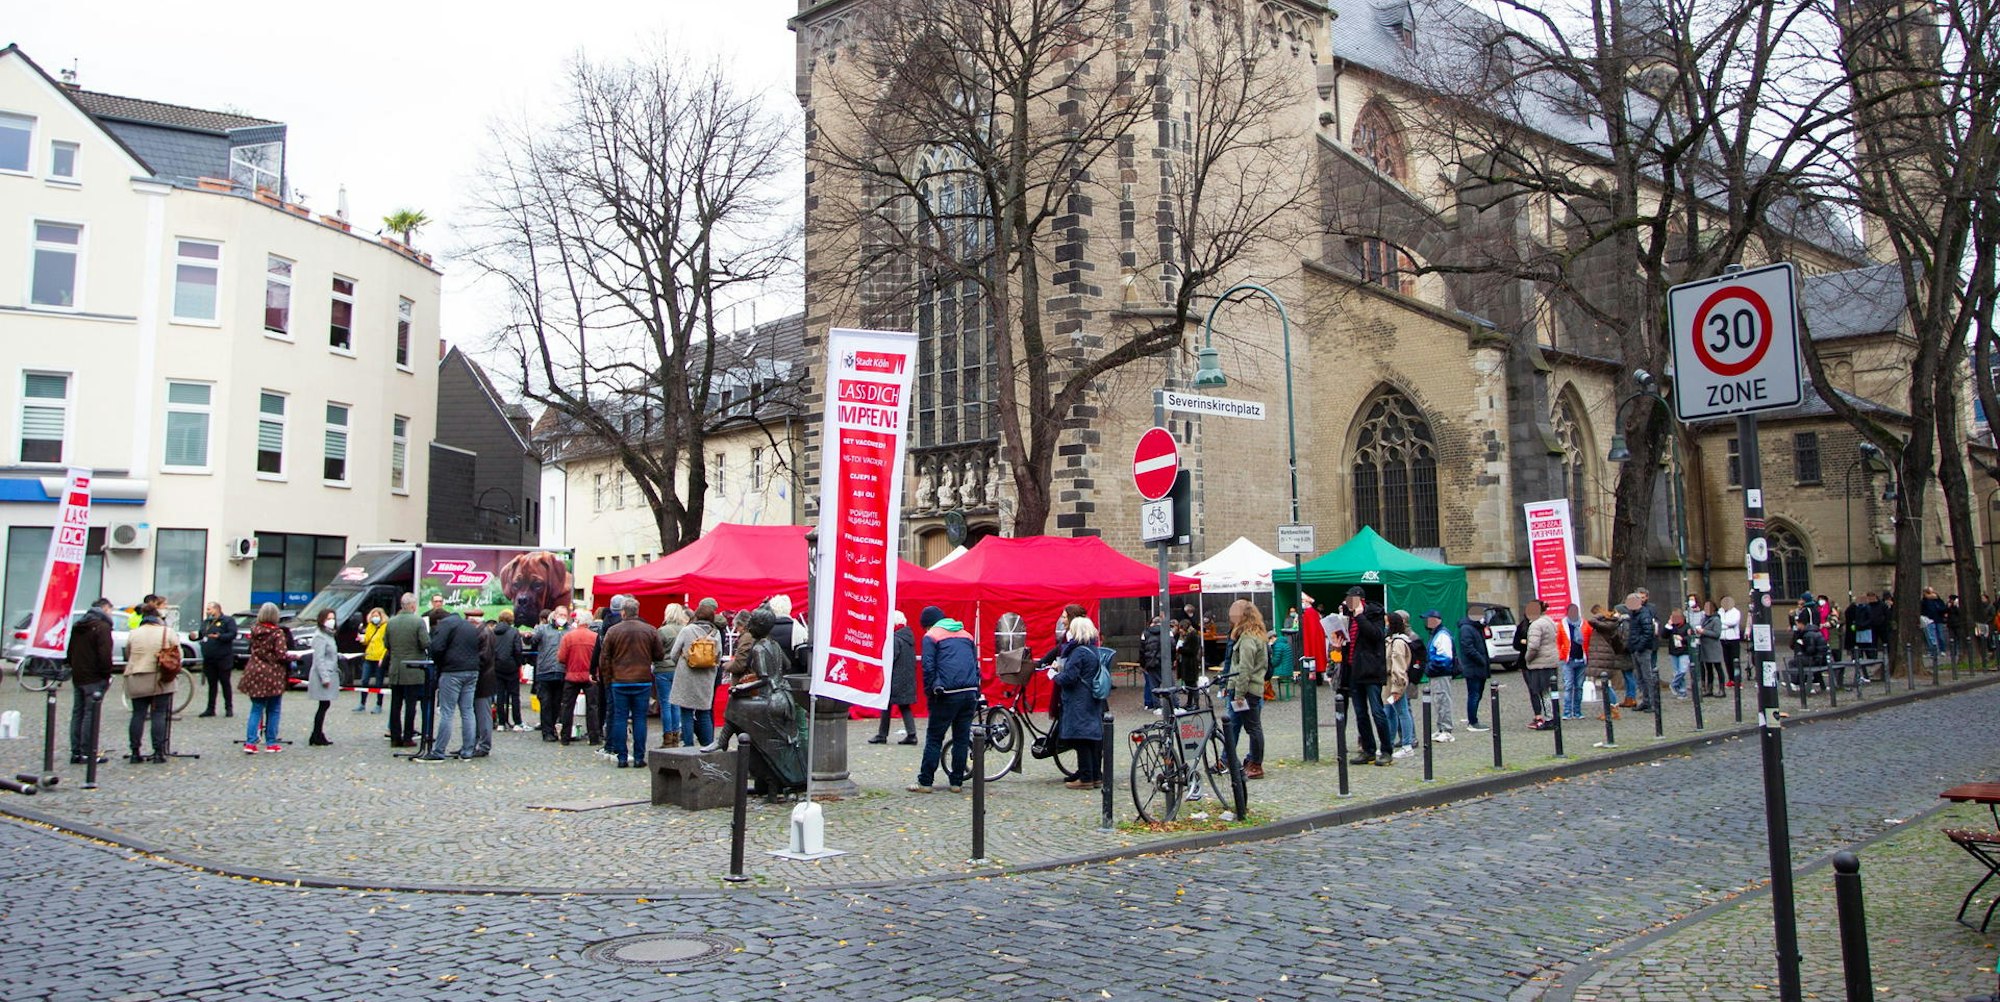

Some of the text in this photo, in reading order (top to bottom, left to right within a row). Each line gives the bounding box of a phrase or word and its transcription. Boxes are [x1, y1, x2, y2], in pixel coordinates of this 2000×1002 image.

[1708, 309, 1755, 353] 30
[856, 356, 889, 369] Stadt Köln
[839, 383, 899, 403] LASS DICH
[1706, 378, 1768, 407] ZONE
[1168, 394, 1260, 416] Severinskirchplatz
[838, 405, 898, 429] IMPFEN!
